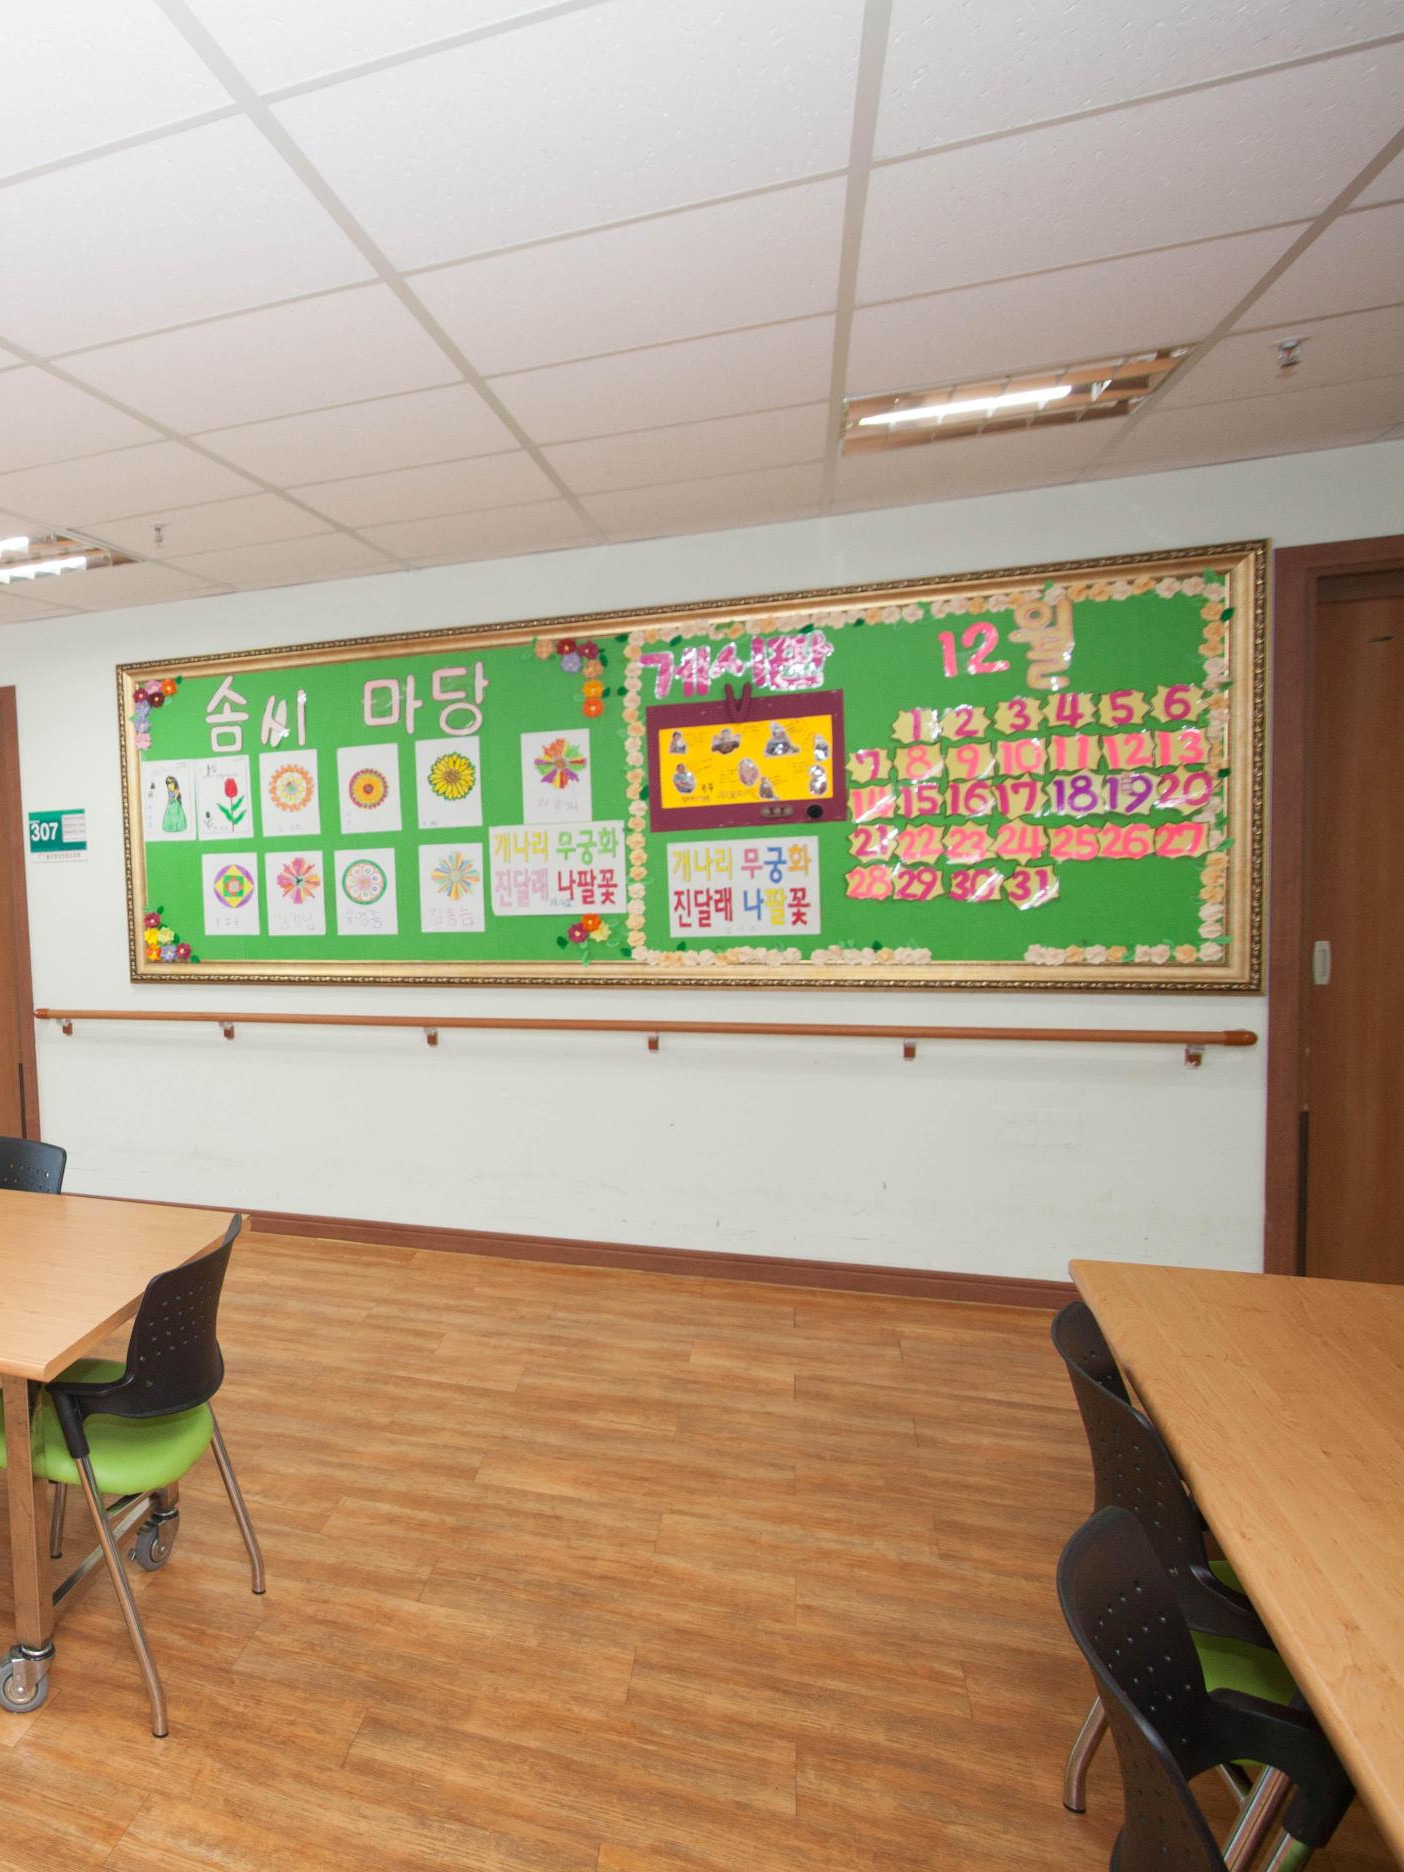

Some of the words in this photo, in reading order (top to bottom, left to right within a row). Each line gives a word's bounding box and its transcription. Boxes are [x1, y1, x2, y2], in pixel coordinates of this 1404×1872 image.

[206, 676, 307, 752] 솜씨
[363, 662, 488, 735] 마당
[912, 709, 921, 740] 1
[955, 708, 979, 737] 2
[1008, 699, 1031, 730] 3
[1056, 693, 1084, 726] 4
[1109, 690, 1134, 724] 5
[1163, 685, 1191, 720] 6
[855, 750, 880, 779] 7
[905, 745, 933, 780] 8
[955, 744, 981, 779] 9
[1000, 739, 1042, 774] 10
[1053, 734, 1089, 770] 11
[1103, 733, 1153, 769] 12
[1156, 731, 1204, 766] 13
[851, 787, 892, 822] 14
[898, 783, 939, 818] 15
[949, 781, 992, 814] 16
[996, 782, 1038, 815] 17
[1054, 775, 1098, 812] 18
[1106, 775, 1153, 813] 19
[1156, 771, 1213, 807] 20
[31, 822, 58, 841] 307
[556, 827, 618, 865] 무궁화
[853, 825, 888, 856] 21
[898, 824, 944, 859] 22
[948, 828, 988, 859] 23
[996, 826, 1046, 859] 24
[1050, 827, 1099, 861] 25
[1099, 824, 1150, 858] 26
[1155, 822, 1204, 857] 27
[672, 848, 733, 882] 개나리
[741, 844, 811, 883] 무궁화
[495, 868, 548, 907] 진달래
[558, 869, 618, 905] 나팔꽃
[847, 865, 892, 900] 28
[897, 867, 937, 901] 29
[949, 869, 996, 902] 30
[1008, 869, 1049, 900] 31
[674, 887, 733, 928] 진달래
[743, 887, 811, 926] 나팔꽃
